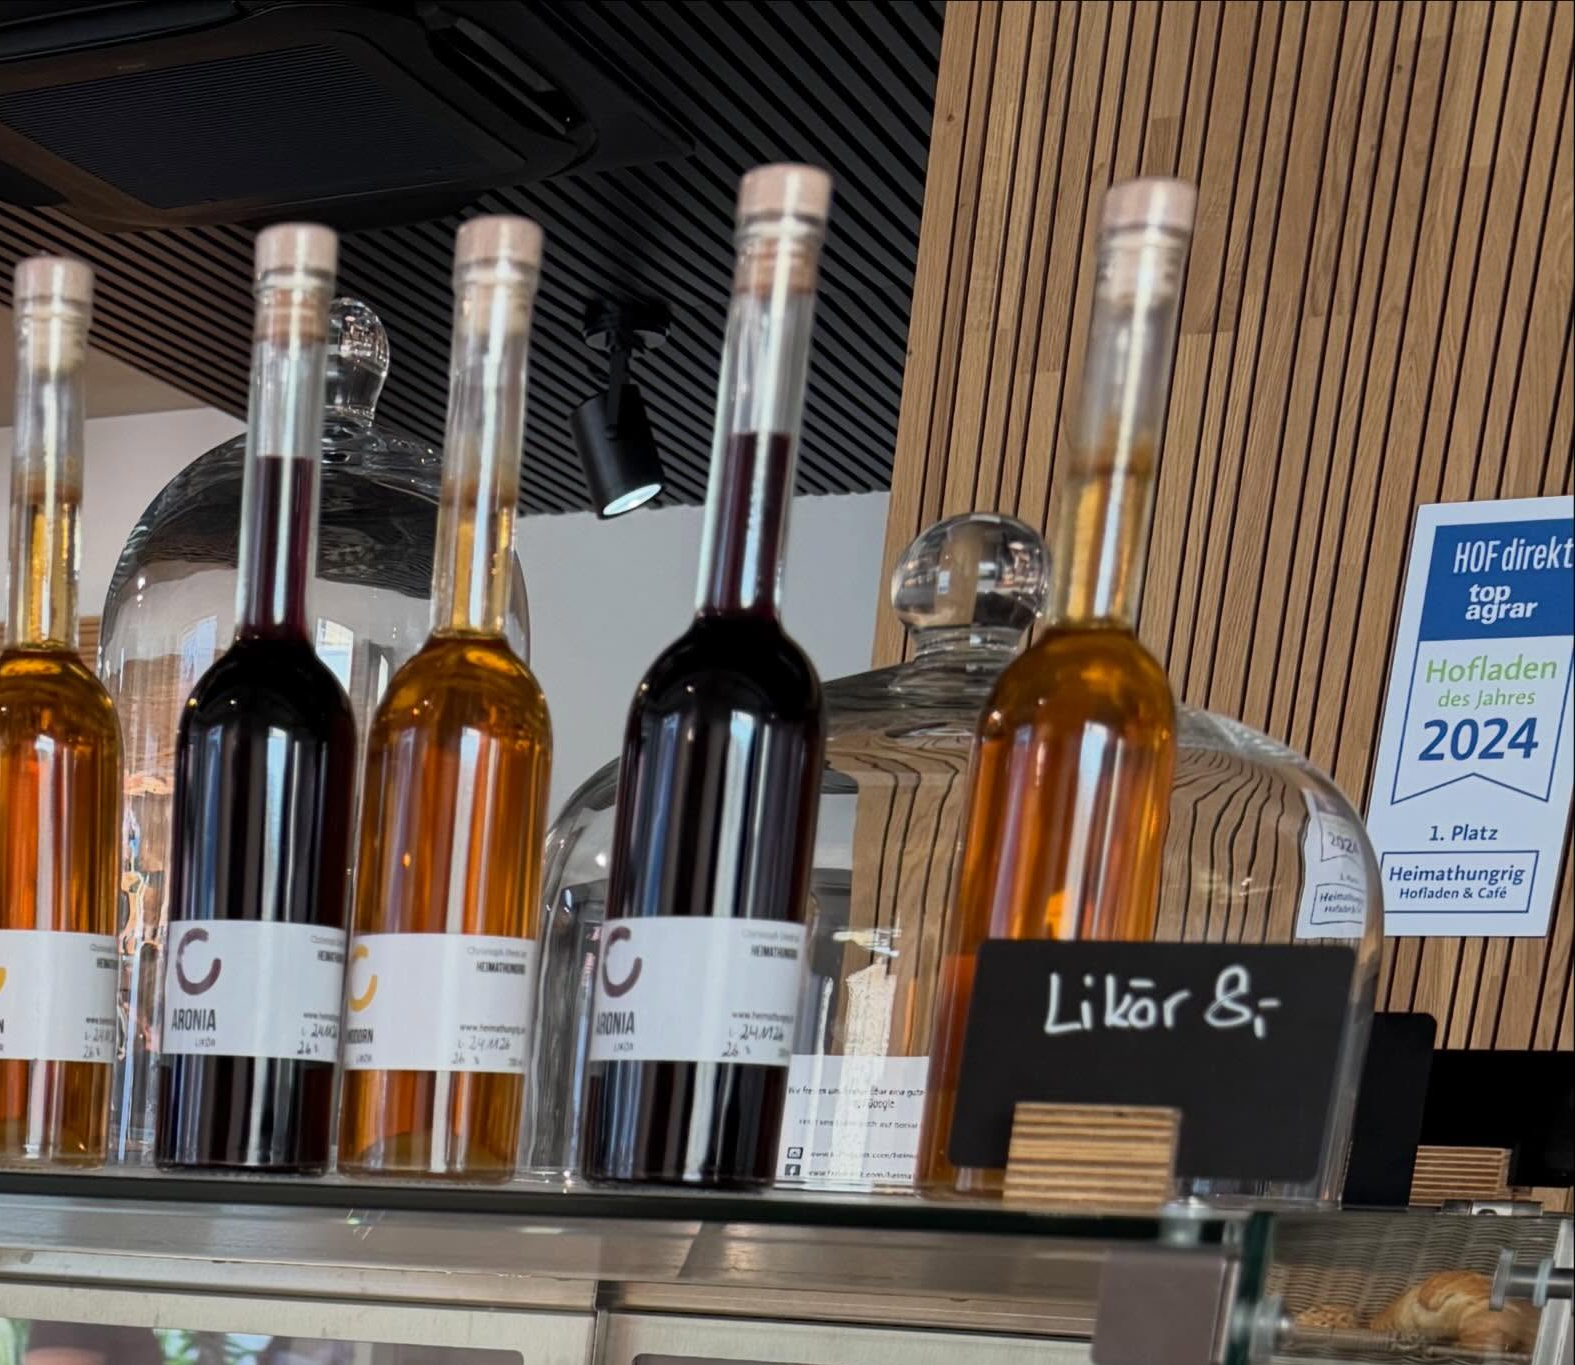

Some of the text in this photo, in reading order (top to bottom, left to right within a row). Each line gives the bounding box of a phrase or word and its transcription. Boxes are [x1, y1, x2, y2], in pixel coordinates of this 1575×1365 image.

[1453, 536, 1574, 574] HOF direkt
[1469, 584, 1510, 606] top
[1465, 601, 1538, 624] agrar
[1425, 654, 1557, 683] Hofladen
[1438, 688, 1535, 707] des Jahres
[1418, 717, 1539, 762] 2024
[1428, 823, 1499, 841] 1. Platz
[1389, 864, 1526, 886] Heimathungrig
[1399, 885, 1508, 900] Hofladen & Café
[1043, 971, 1191, 1034] Likör
[171, 1008, 217, 1032] ARONIA
